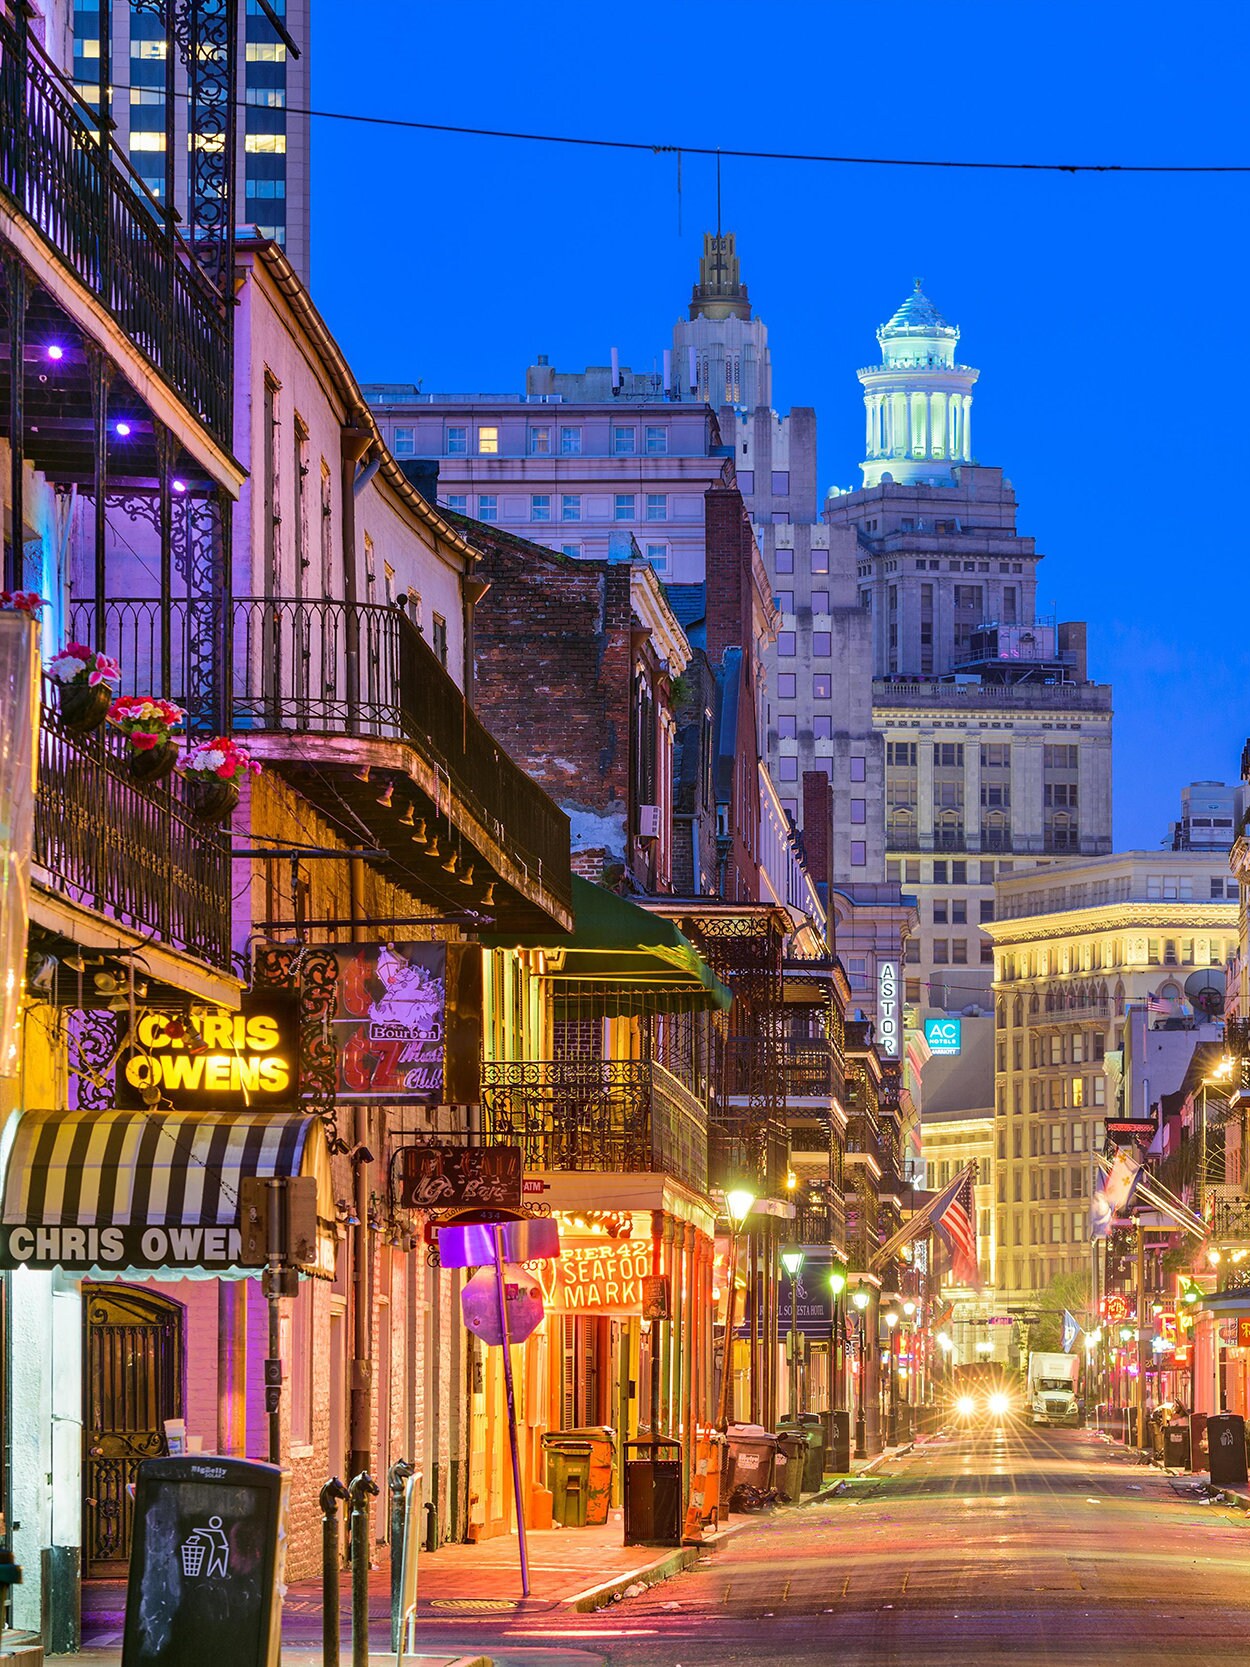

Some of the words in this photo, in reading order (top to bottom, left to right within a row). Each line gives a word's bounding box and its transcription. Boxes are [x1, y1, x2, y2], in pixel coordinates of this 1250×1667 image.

[881, 964, 895, 1055] ASTOR
[929, 1023, 956, 1039] AC
[125, 1055, 289, 1092] OWENS
[523, 1181, 542, 1191] ATM
[8, 1226, 124, 1262] CHRIS
[141, 1226, 242, 1262] OWEN
[560, 1246, 615, 1263] PIER
[563, 1256, 649, 1285] SEAFOO
[563, 1278, 643, 1309] MARK
[783, 1304, 810, 1316] SOESTA
[810, 1304, 824, 1316] HOTEL
